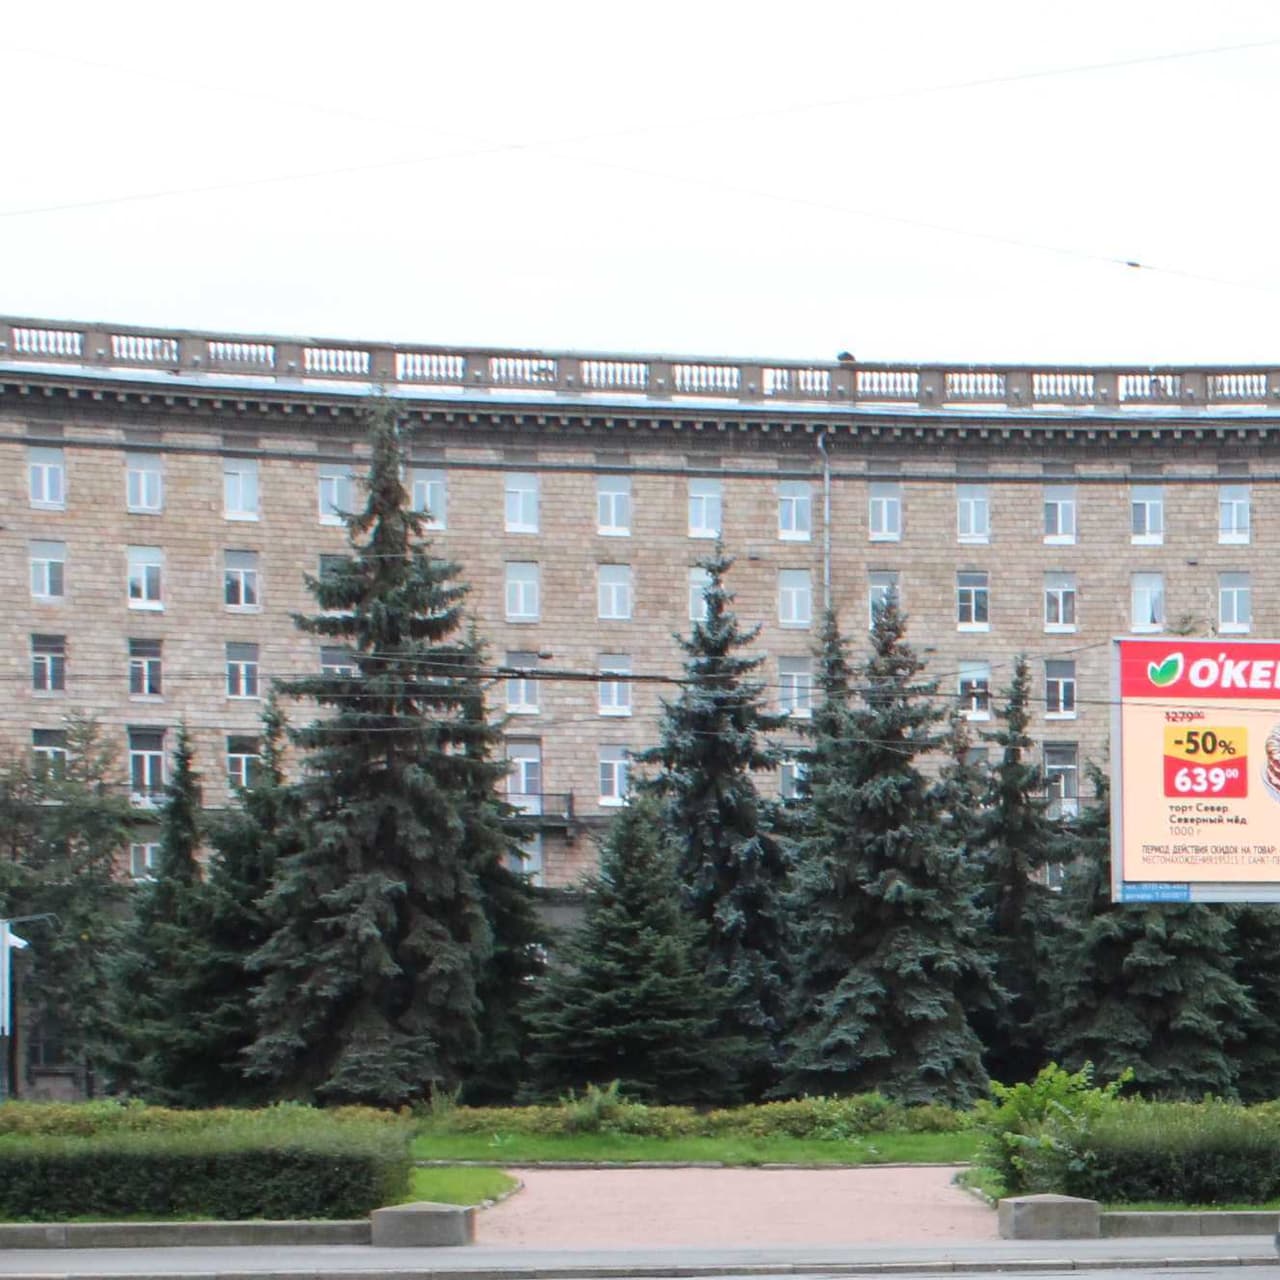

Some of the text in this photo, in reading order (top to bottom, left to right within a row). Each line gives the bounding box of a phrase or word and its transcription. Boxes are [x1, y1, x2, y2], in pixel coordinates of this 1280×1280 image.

[1174, 731, 1236, 755] -50%
[1169, 803, 1229, 814] торт Север
[1169, 815, 1224, 826] Северный
[1142, 845, 1170, 854] ПЕРИОД
[1173, 844, 1209, 854] ДЕЙСТВИЯ
[1211, 846, 1239, 854] СКИДОК
[1241, 846, 1252, 854] НА
